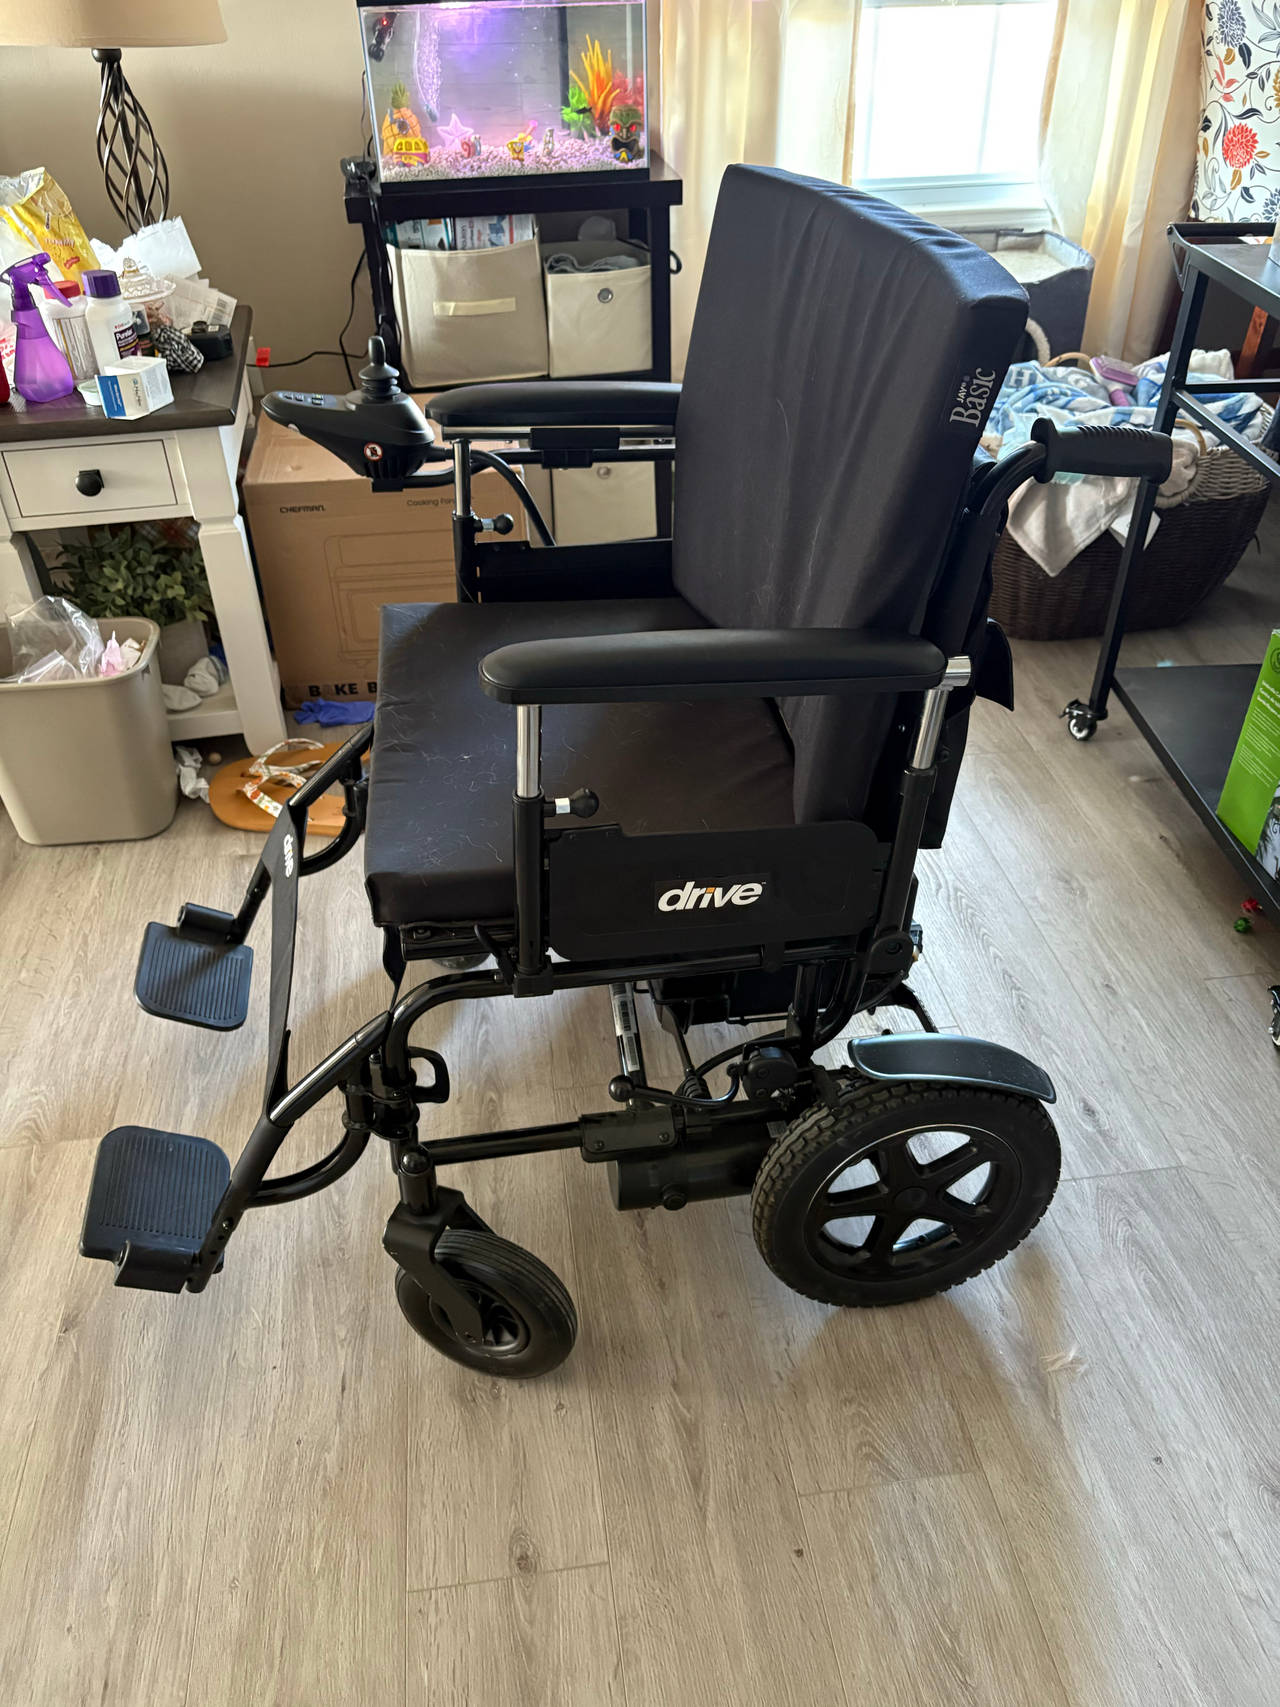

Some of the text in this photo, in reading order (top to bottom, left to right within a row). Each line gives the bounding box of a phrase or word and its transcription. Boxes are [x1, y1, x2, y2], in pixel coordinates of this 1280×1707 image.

[949, 367, 996, 428] Basic
[406, 498, 439, 507] Cooking
[658, 881, 764, 912] drive
